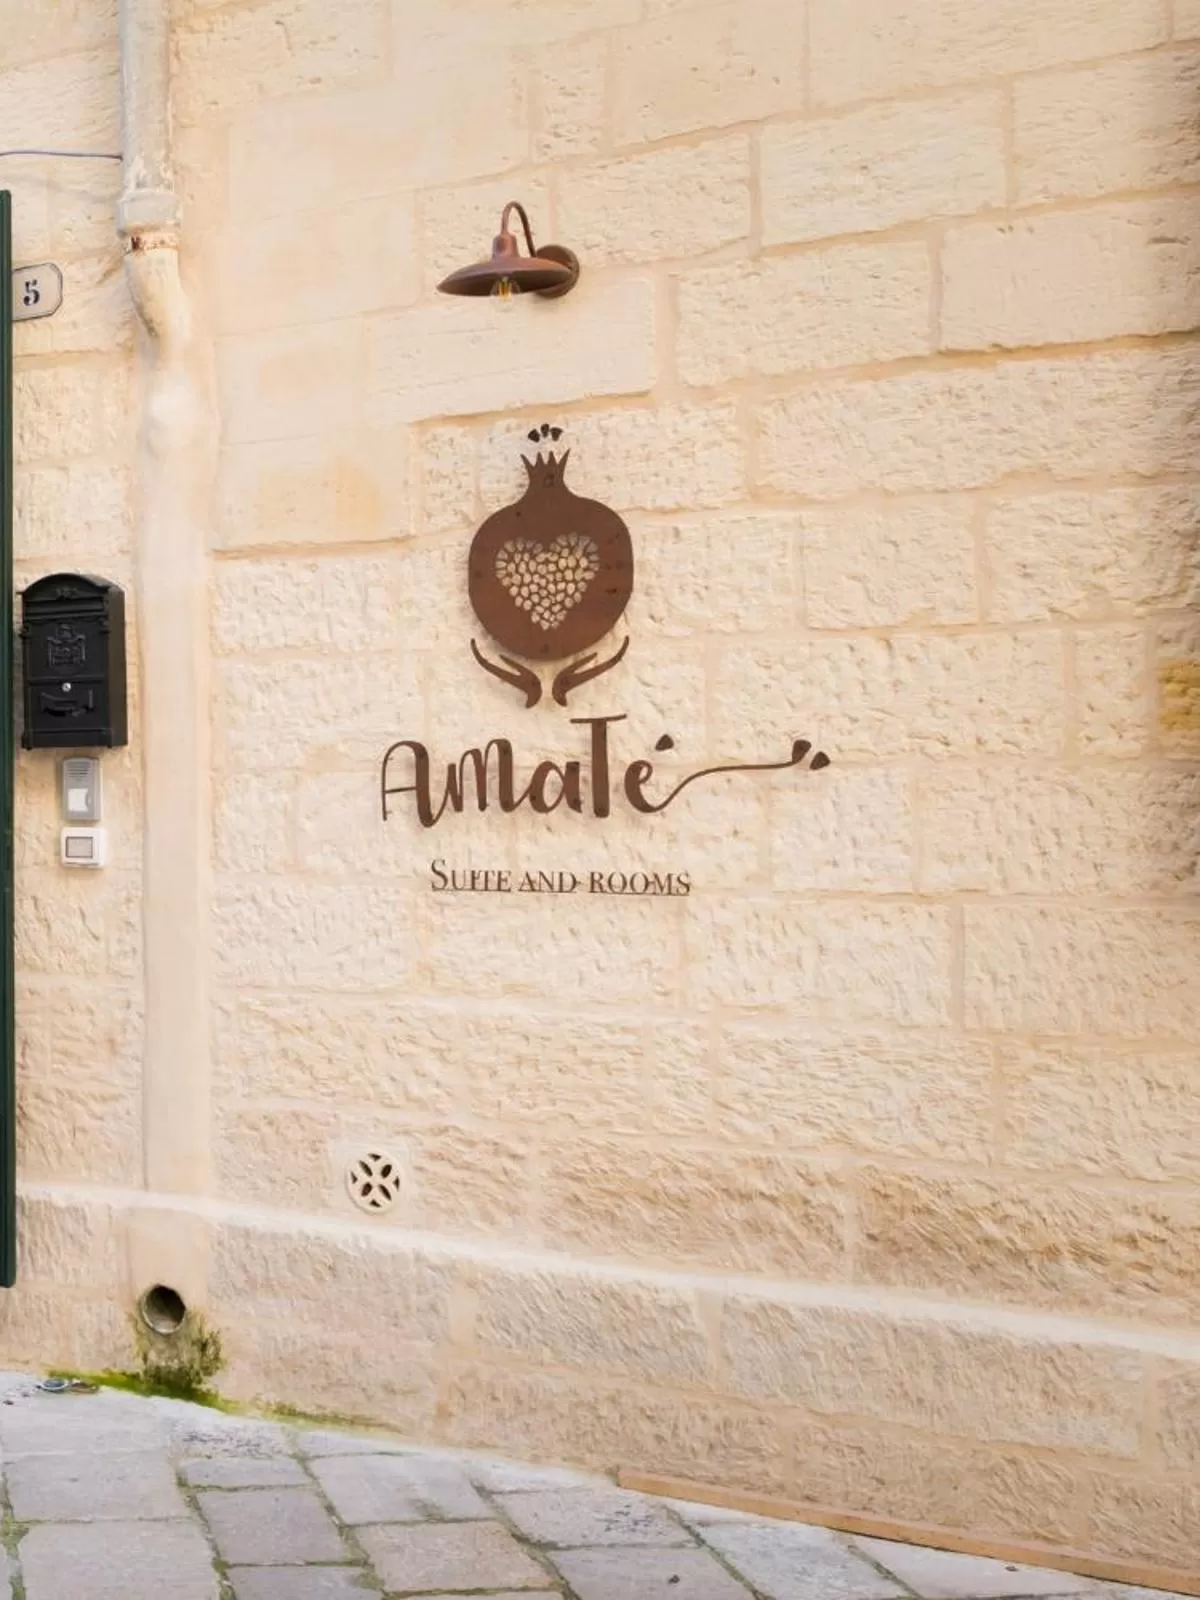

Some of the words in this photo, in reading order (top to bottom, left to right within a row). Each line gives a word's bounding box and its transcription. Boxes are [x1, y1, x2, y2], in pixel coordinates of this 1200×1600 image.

[23, 279, 40, 306] 5
[518, 869, 578, 893] AND
[587, 870, 690, 896] ROOMS
